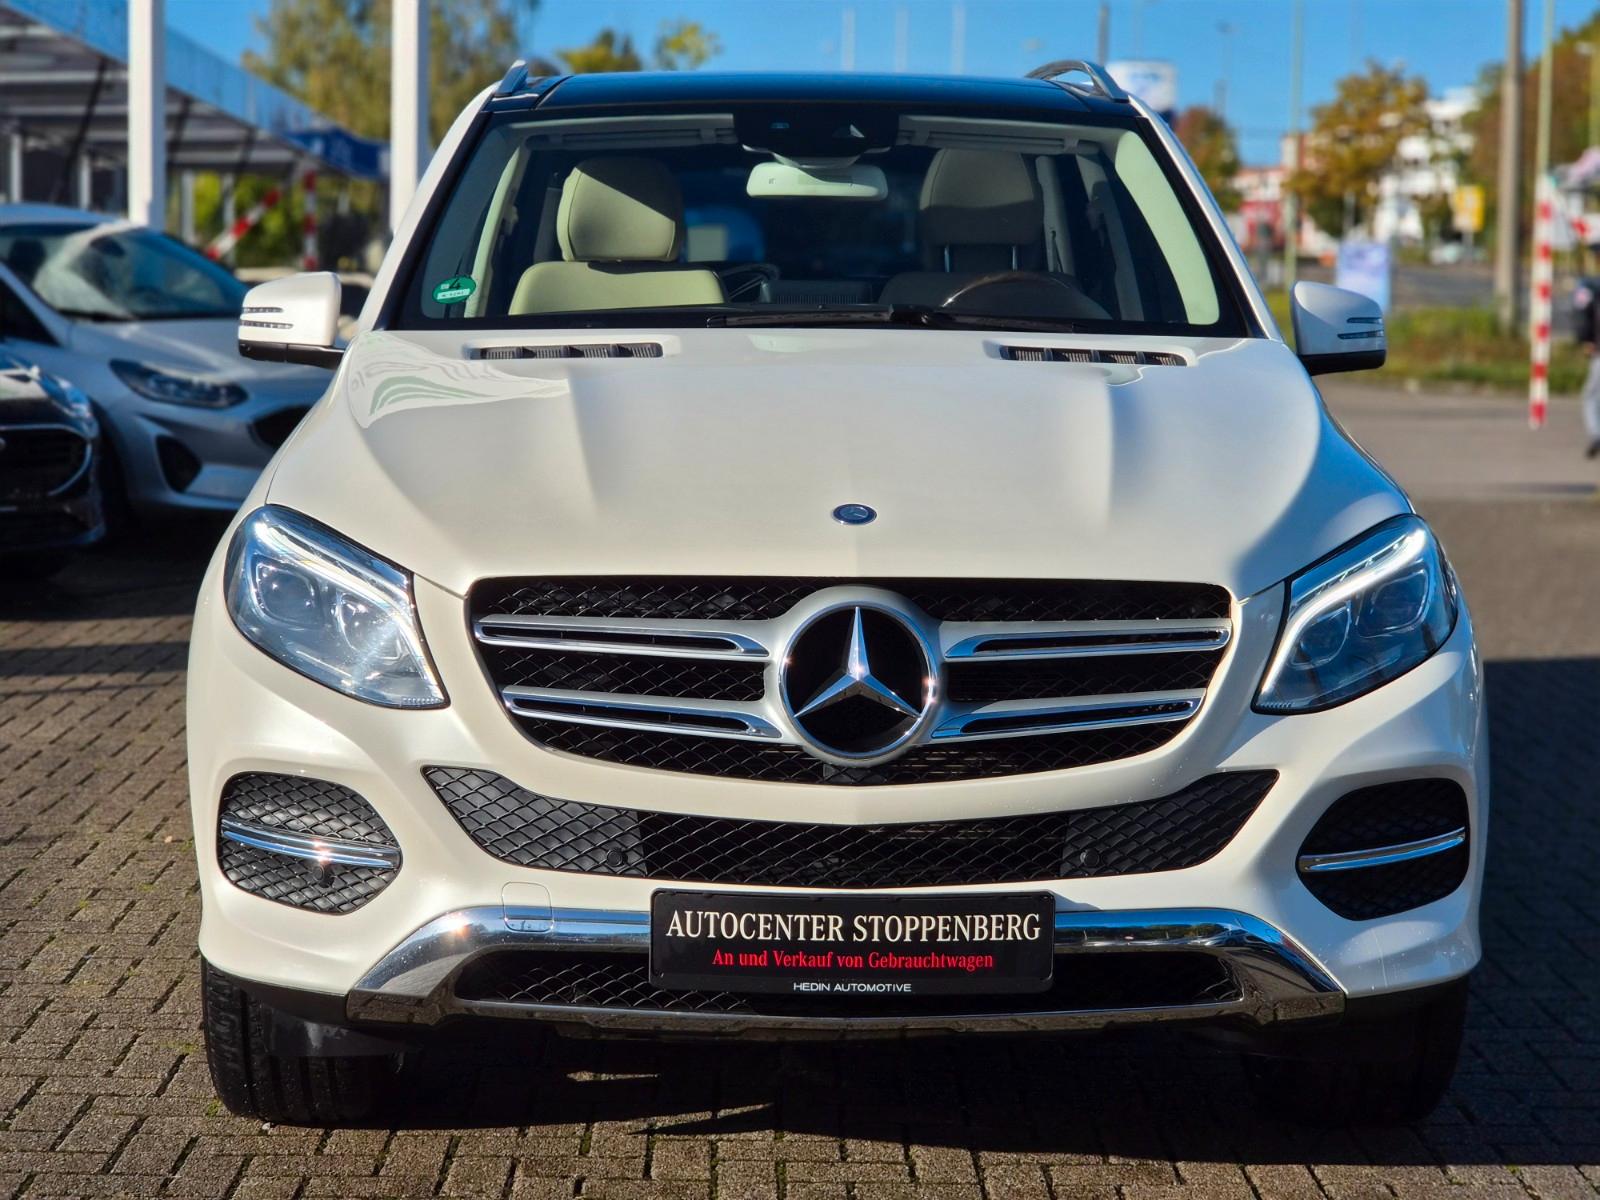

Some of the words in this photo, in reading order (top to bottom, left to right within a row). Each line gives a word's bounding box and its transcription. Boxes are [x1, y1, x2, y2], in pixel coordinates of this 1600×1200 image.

[665, 910, 844, 942] AUTOCENTER
[853, 914, 1041, 942] STOPPENBERG
[712, 948, 734, 966] An
[739, 950, 768, 967] und
[774, 950, 834, 968] Verkauf
[837, 955, 863, 969] von
[868, 952, 994, 972] Gebrauchtwagen
[793, 982, 830, 992] HEDIN
[834, 983, 912, 993] AUTOMOTIVE
